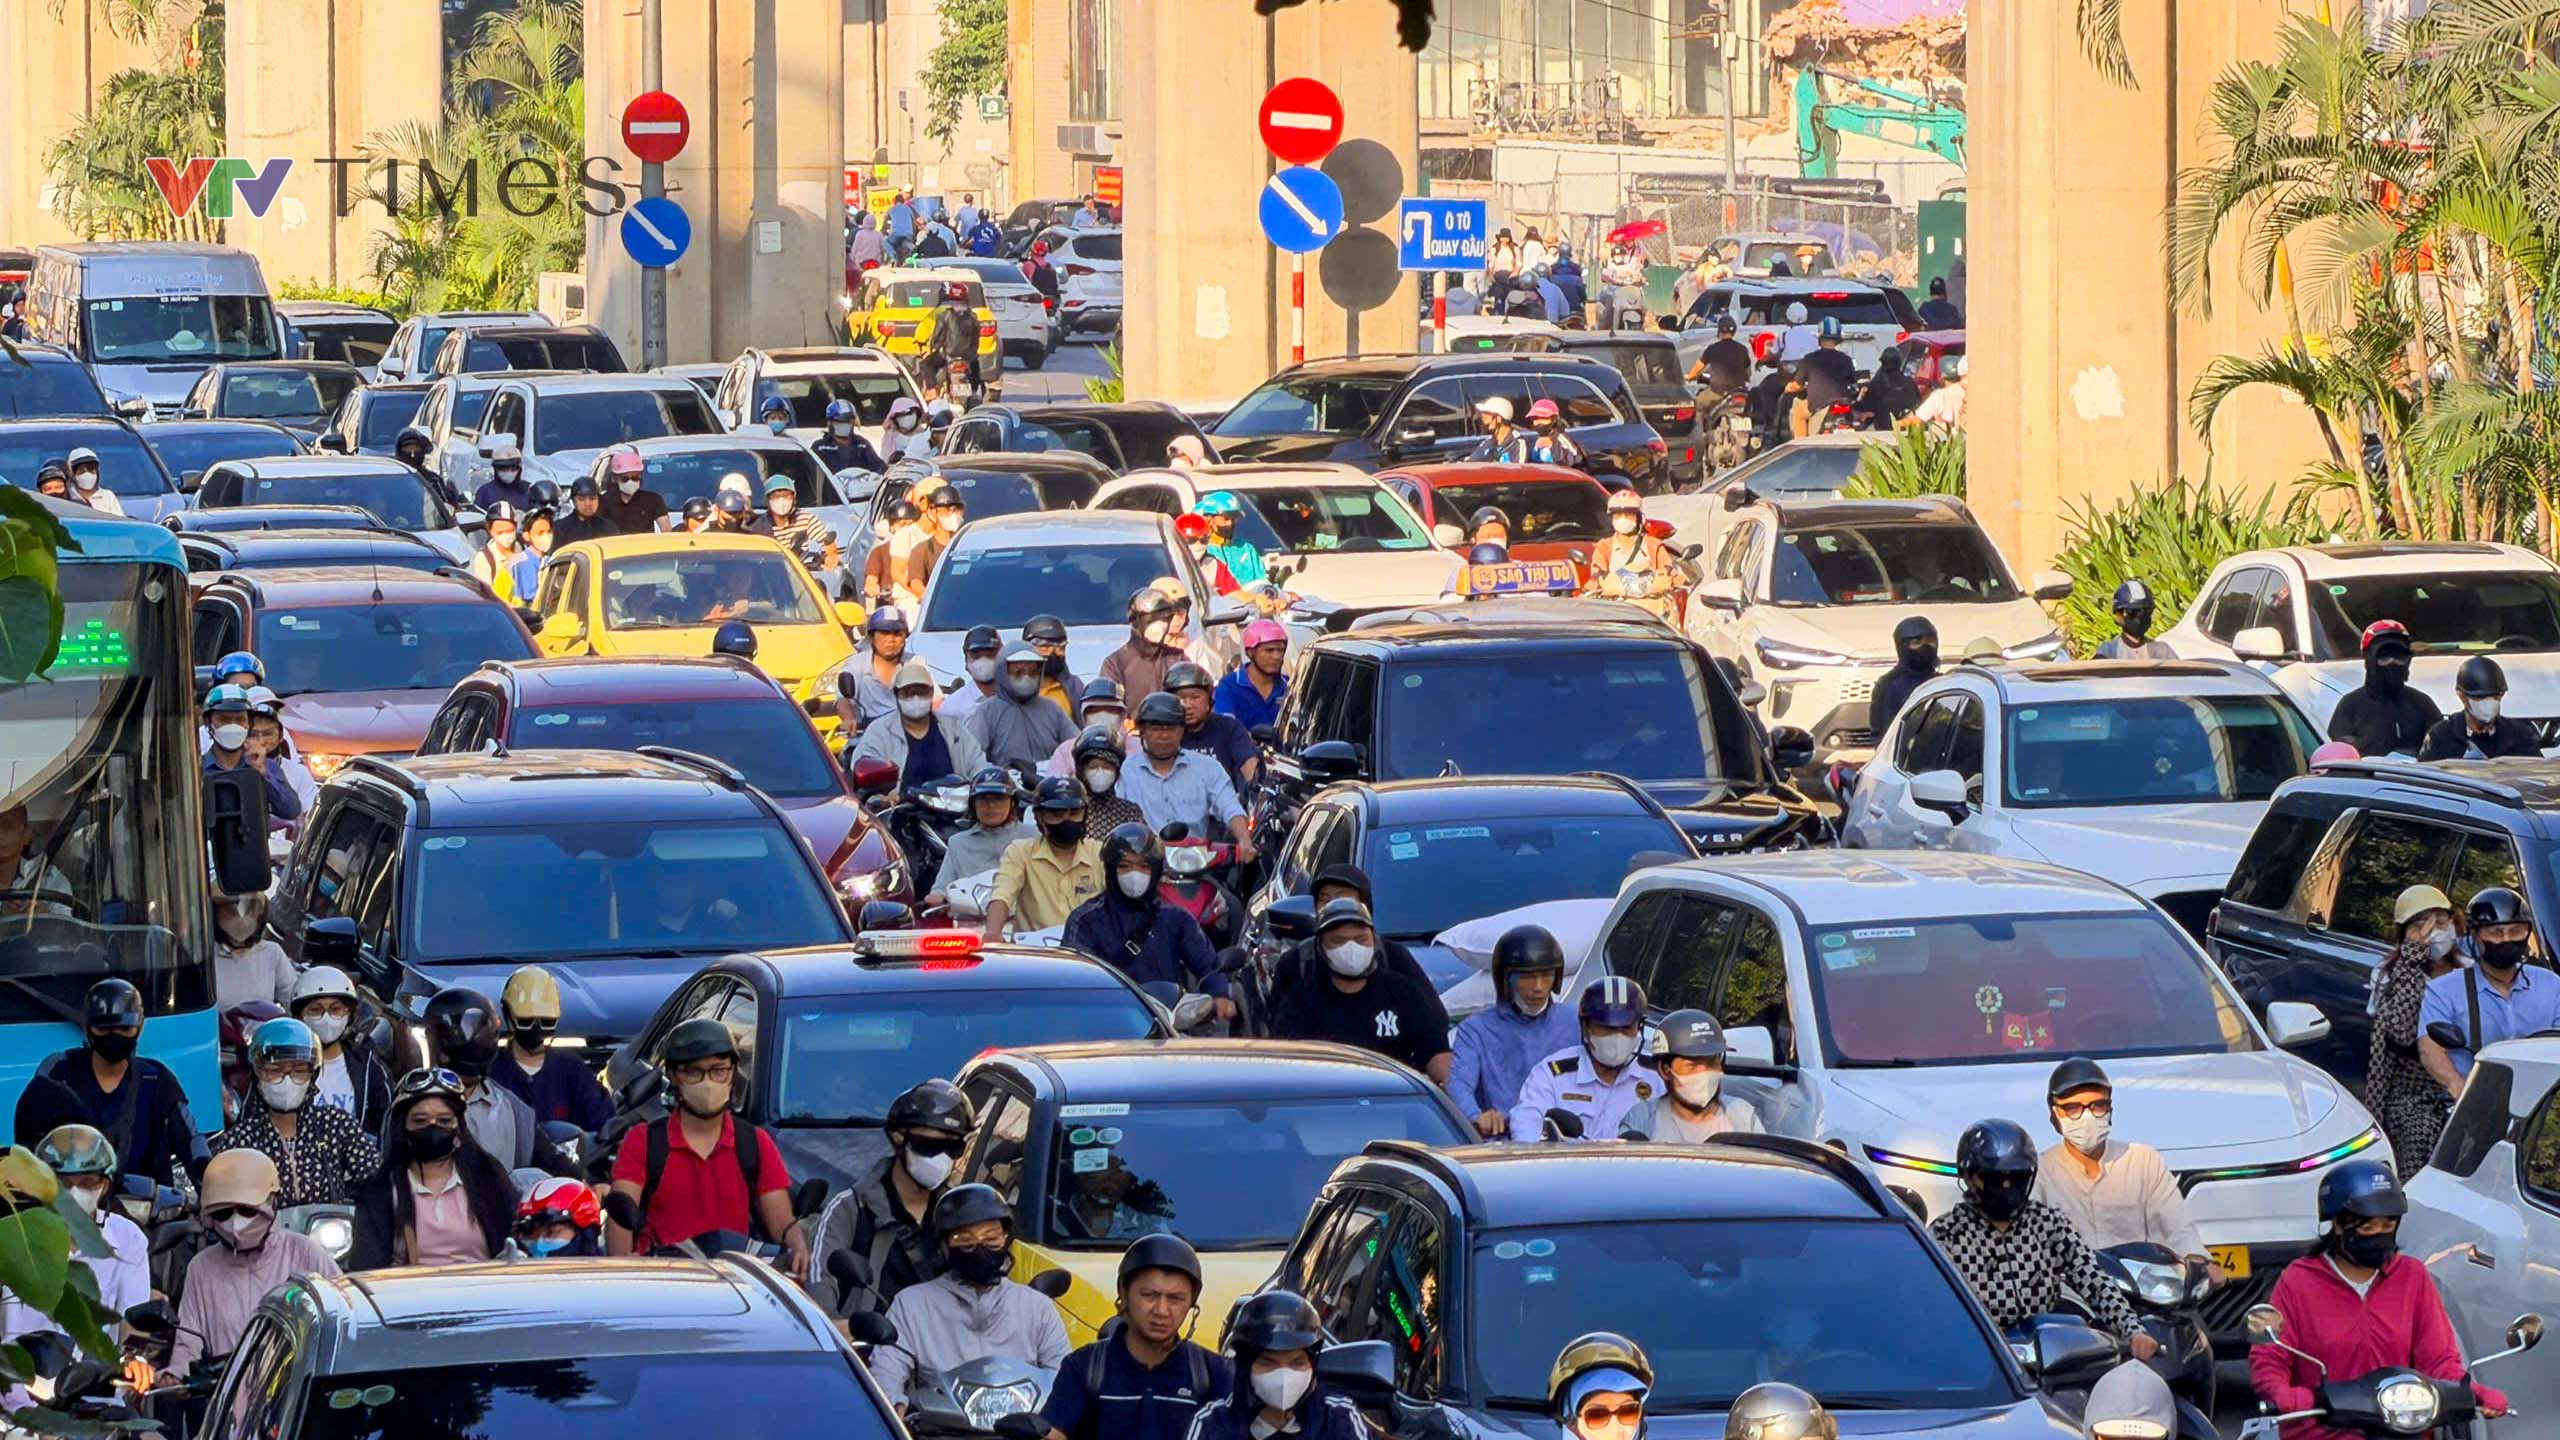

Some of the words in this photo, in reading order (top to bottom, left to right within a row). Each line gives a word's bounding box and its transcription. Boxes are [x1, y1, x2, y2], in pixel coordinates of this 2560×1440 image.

[1456, 209, 1472, 231] TÔ
[1431, 239, 1460, 257] QUAY
[1460, 232, 1485, 257] ĐẦU
[1498, 567, 1524, 585] SAO
[1375, 1009, 1400, 1038] NY
